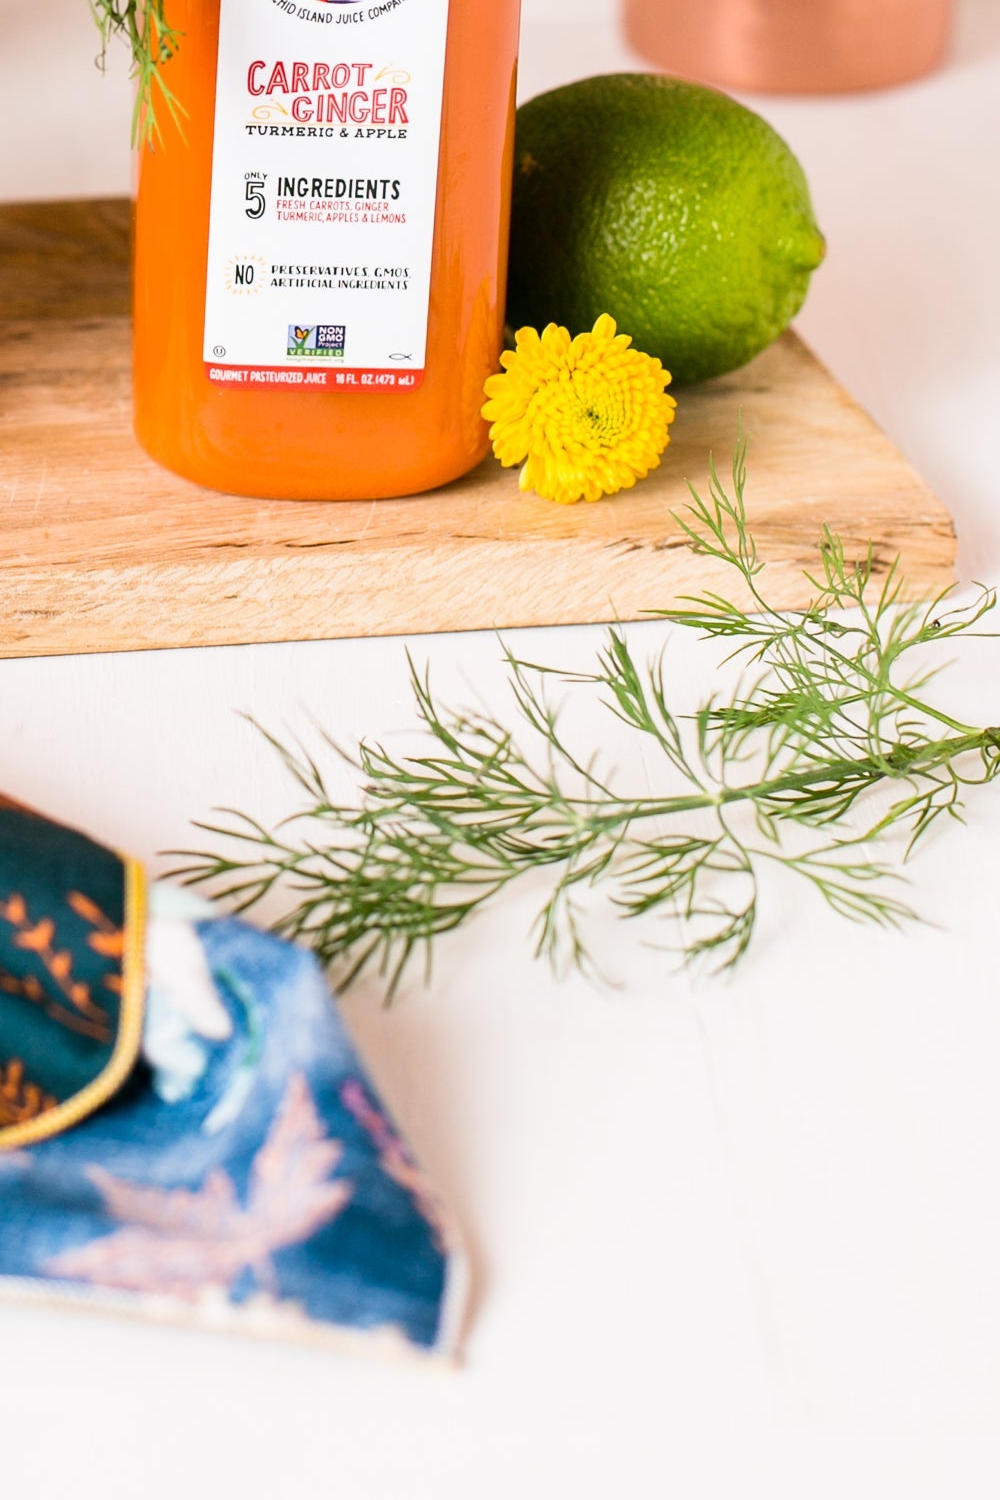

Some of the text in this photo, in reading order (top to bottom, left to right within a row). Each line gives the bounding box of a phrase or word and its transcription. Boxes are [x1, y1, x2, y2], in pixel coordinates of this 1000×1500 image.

[296, 8, 333, 24] ISLAND
[336, 13, 364, 24] JUICE
[247, 60, 373, 96] CARROT
[292, 88, 409, 124] GINGER
[246, 125, 407, 139] TURMERIC & APPLE
[244, 172, 268, 180] ONLY
[277, 177, 401, 200] INGREDIENTS
[245, 181, 265, 219] 5
[277, 200, 389, 211] FRESH CARROTS, GINGER
[277, 212, 407, 223] TURMERIC, APPLES & LEMONS
[235, 264, 254, 285] NO
[270, 279, 409, 290] ARTIFICIAL INGREDIENTS
[210, 368, 248, 381] GOURMET
[251, 371, 303, 384] PASTEURIZED
[303, 372, 327, 385] JUICE
